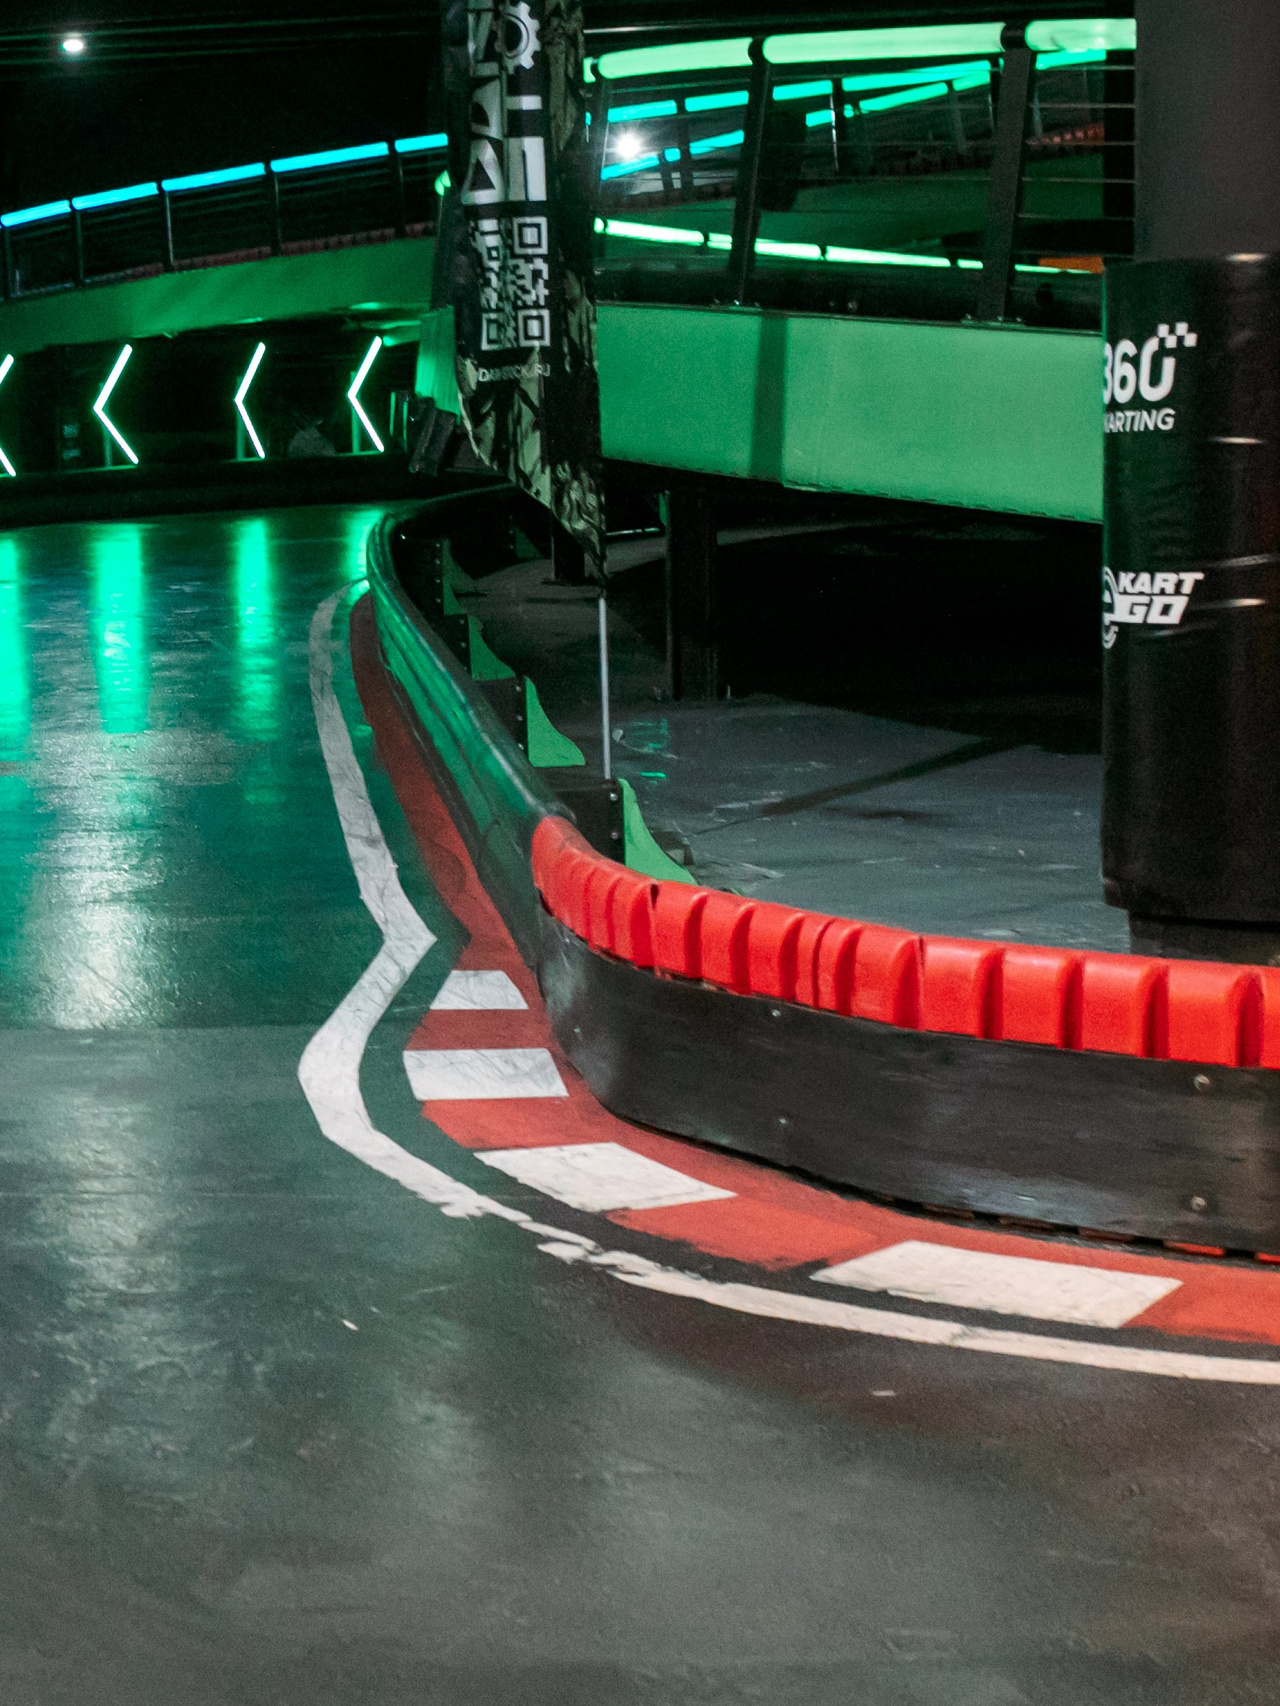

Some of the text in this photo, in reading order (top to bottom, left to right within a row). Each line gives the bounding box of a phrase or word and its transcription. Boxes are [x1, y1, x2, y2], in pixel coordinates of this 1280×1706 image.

[1103, 408, 1176, 433] ARTING
[1119, 571, 1205, 594] KART
[1115, 595, 1189, 624] GO
